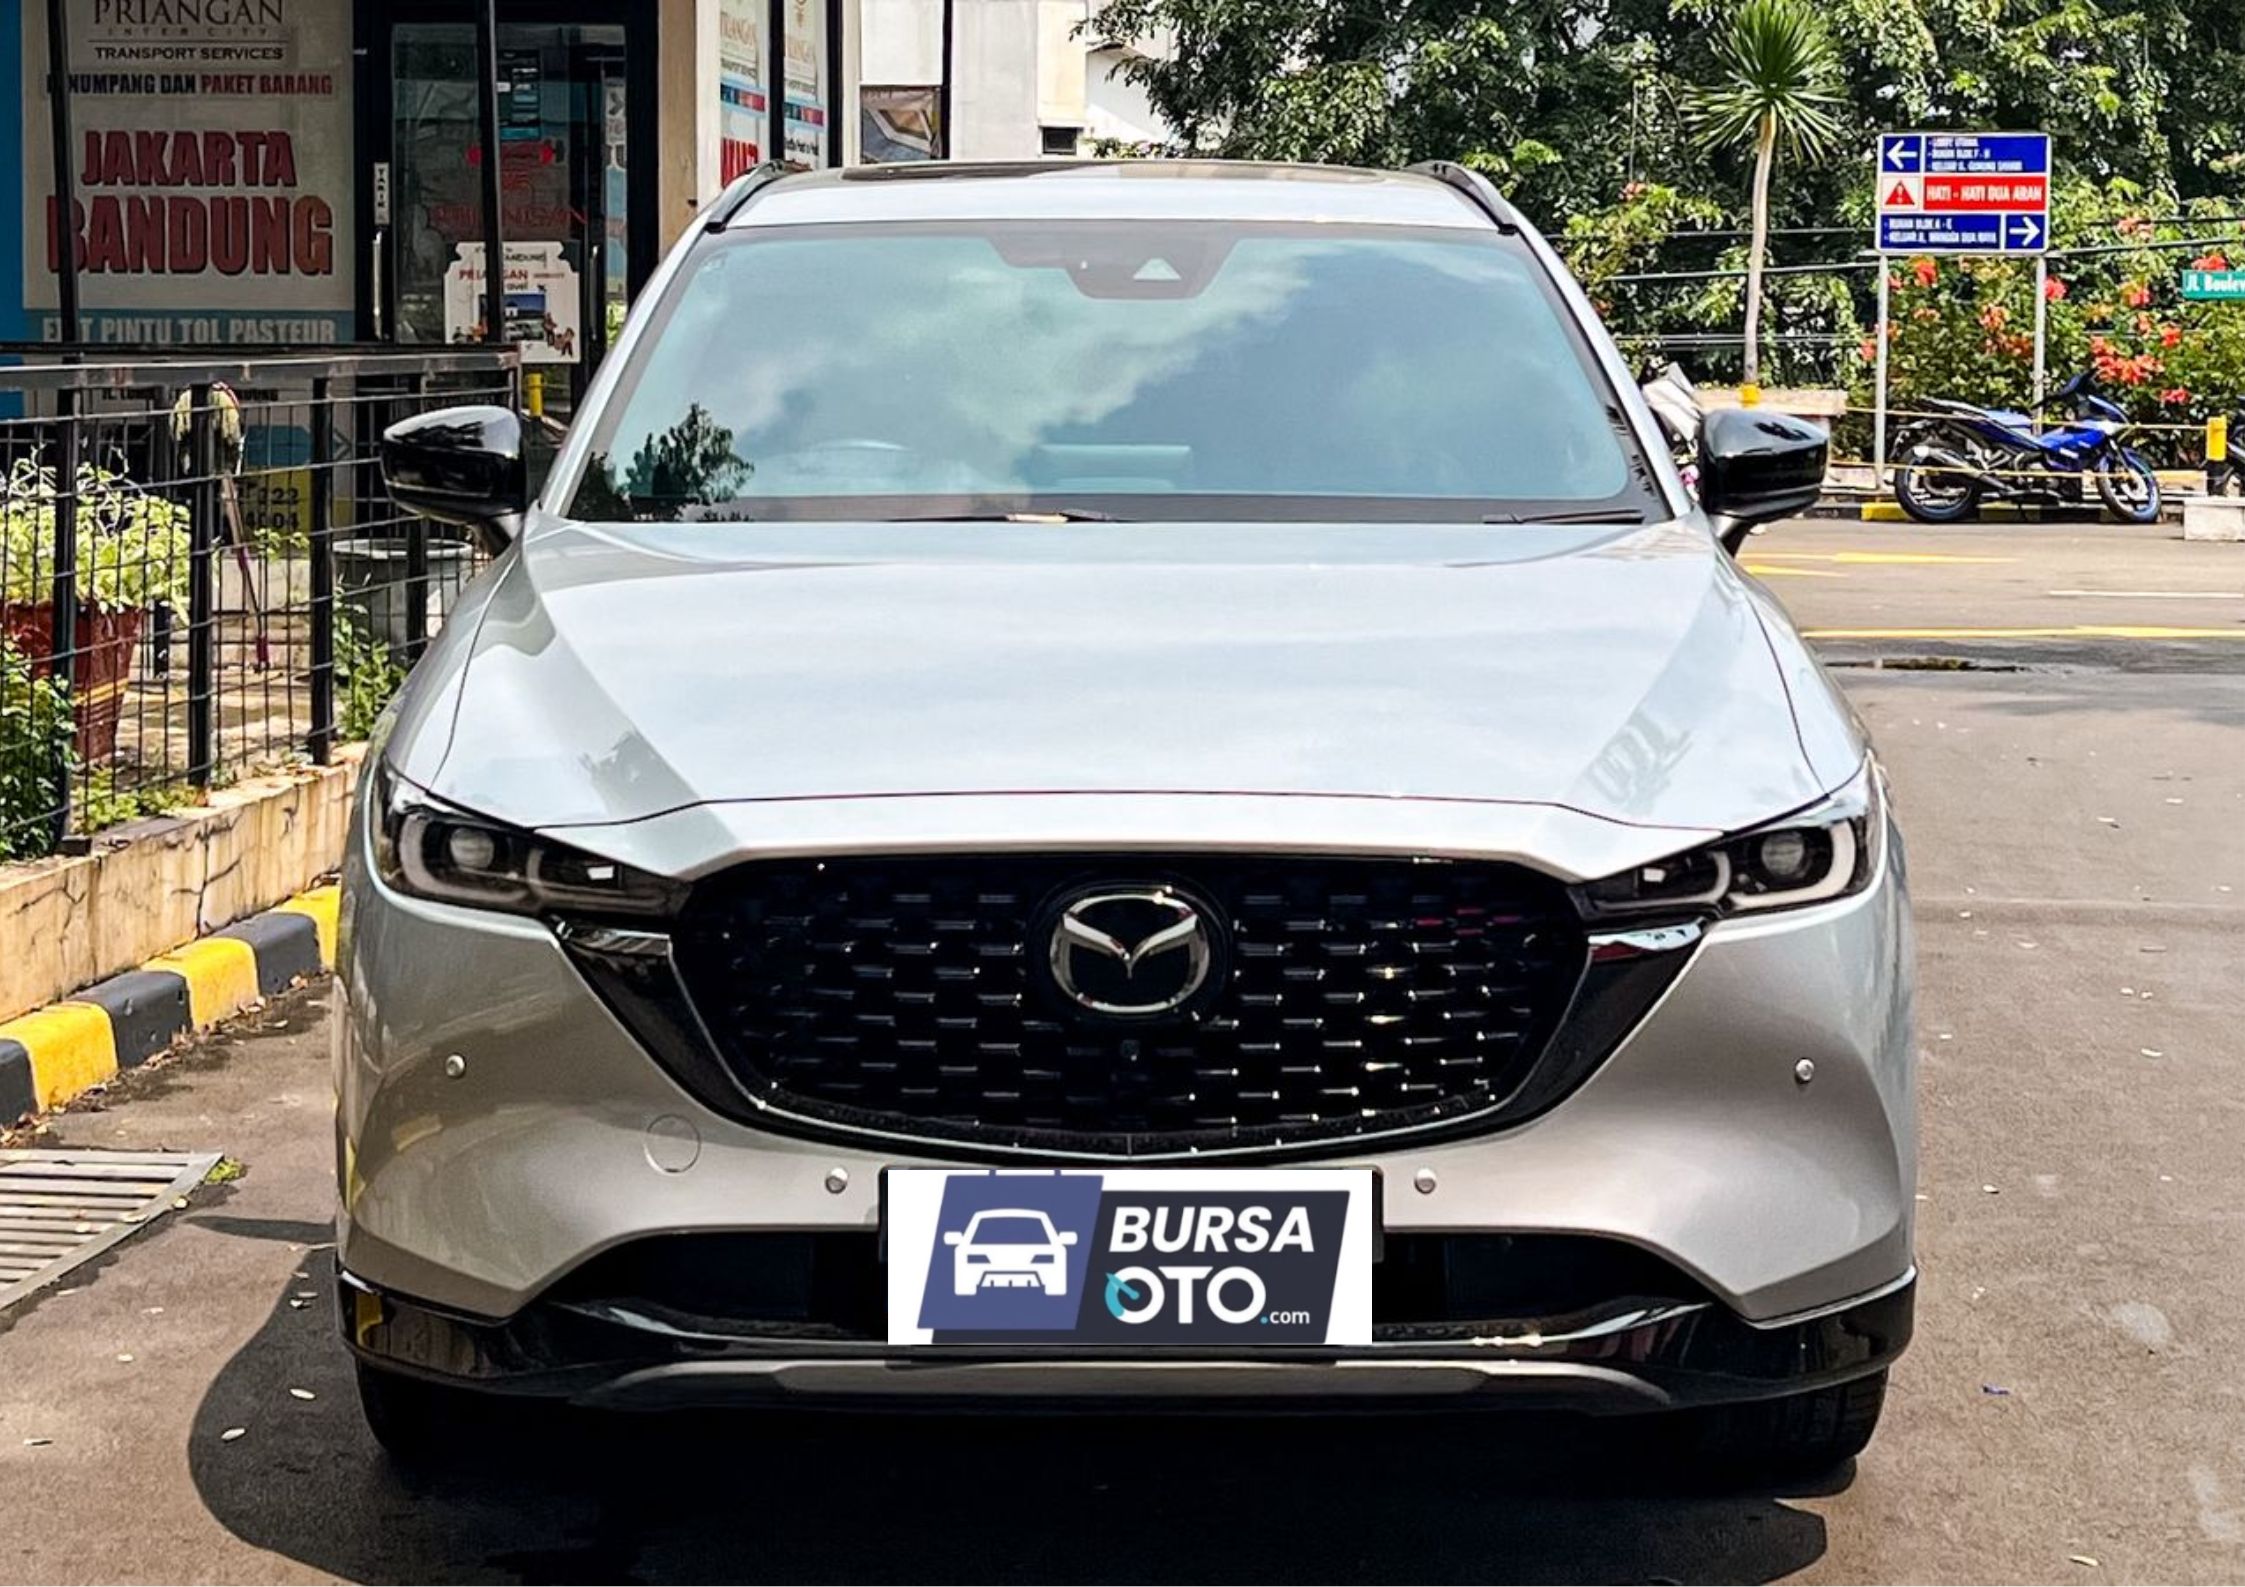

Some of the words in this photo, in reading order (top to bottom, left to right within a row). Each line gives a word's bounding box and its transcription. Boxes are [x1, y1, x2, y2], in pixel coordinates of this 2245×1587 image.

[94, 0, 283, 25] PRIANGAN
[95, 48, 196, 60] TRANSPORT
[200, 48, 284, 60] SERVICES
[46, 75, 155, 94] NUMPANG
[160, 75, 196, 94] DAN
[201, 75, 256, 94] PAKET
[259, 75, 333, 94] BARANG
[81, 131, 297, 187] JAKARTA
[1926, 185, 1952, 201] HATI
[1960, 185, 1986, 201] HATI
[1988, 185, 2010, 201] DUA
[46, 196, 333, 276] BANDUNG
[102, 319, 172, 343] PINTU
[181, 320, 221, 343] TOL
[230, 320, 335, 343] PASTEUR
